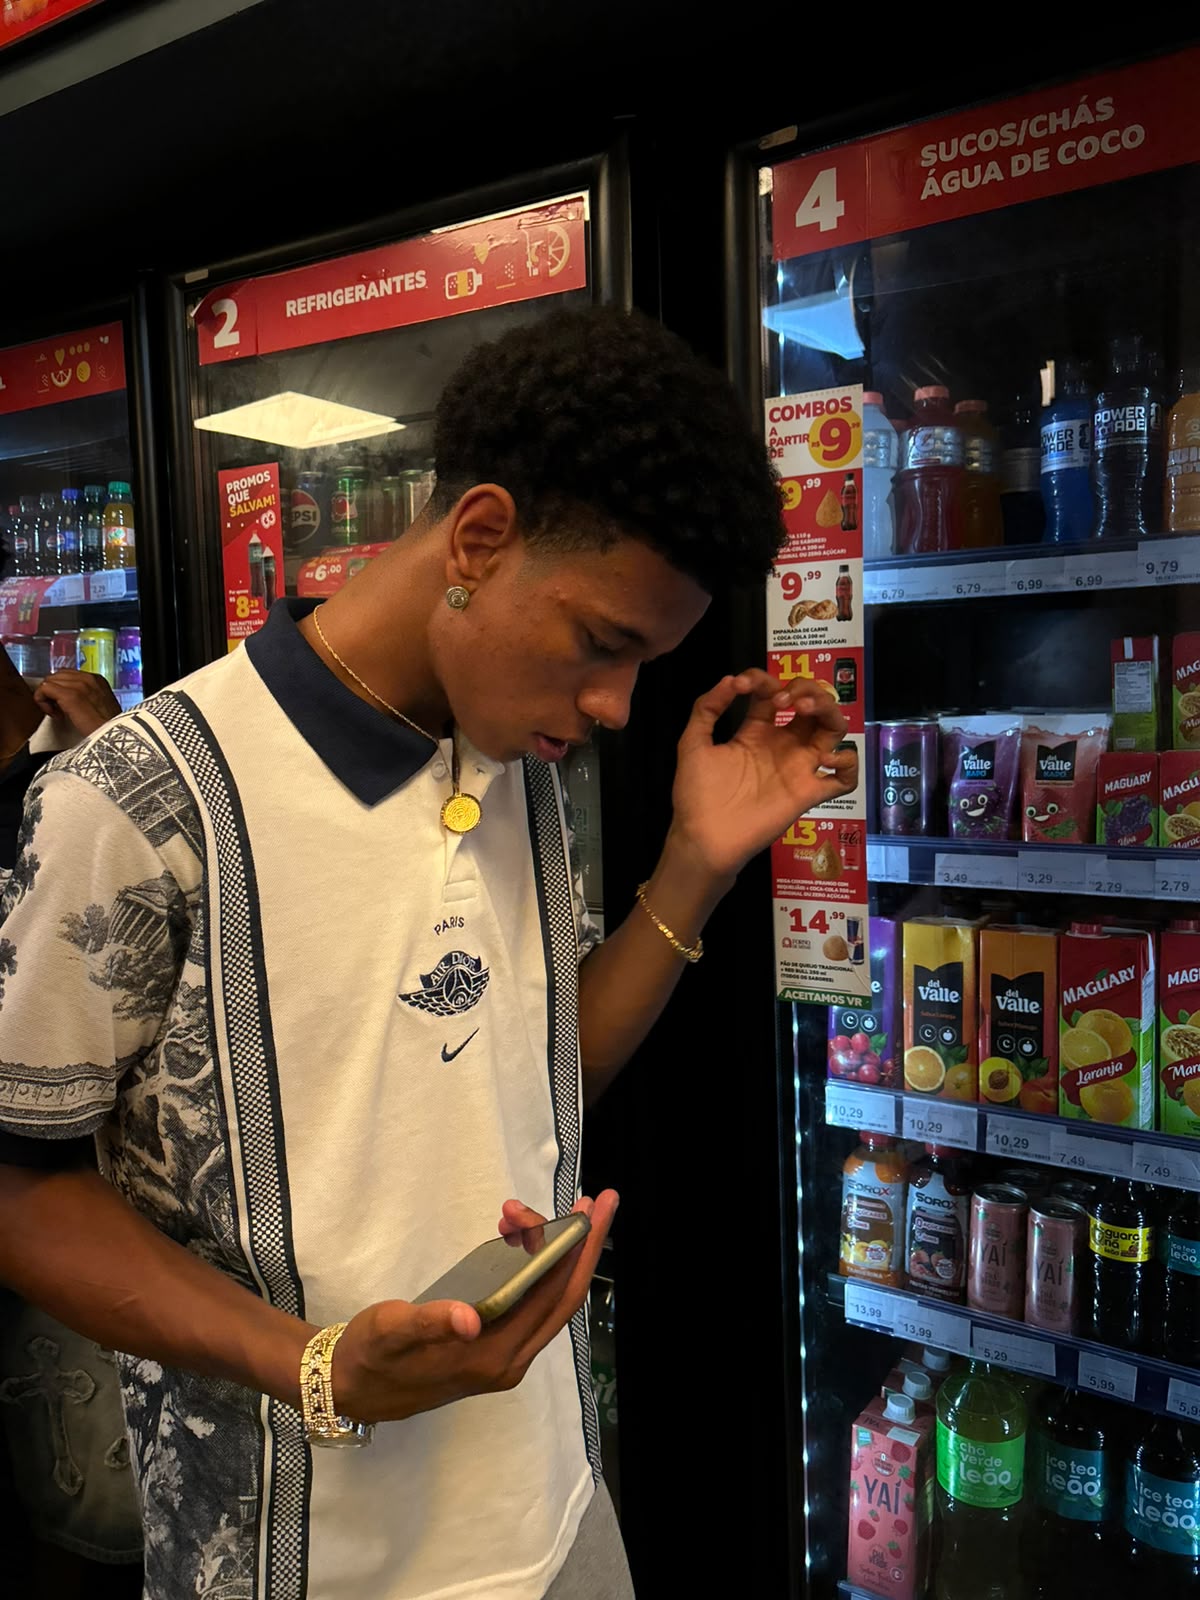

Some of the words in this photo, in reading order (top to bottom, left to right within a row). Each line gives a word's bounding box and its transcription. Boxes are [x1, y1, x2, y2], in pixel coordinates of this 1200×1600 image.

[920, 95, 1116, 168] SUCOS/CHÁS
[920, 161, 1004, 200] ÁGUA
[1010, 153, 1050, 177] DE
[1056, 129, 1146, 170] COCO
[795, 166, 845, 232] 4
[285, 270, 427, 317] REFRIGERANTES
[210, 298, 241, 349] 2
[768, 396, 854, 424] COMBOS
[1094, 405, 1145, 426] POWER
[769, 427, 778, 437] A
[769, 433, 810, 448] PARTIR
[770, 448, 784, 459] DE
[226, 470, 272, 495] PROMOS
[227, 489, 250, 508] QUE
[229, 494, 276, 518] SALVAM!
[1145, 560, 1179, 575] 9,79
[955, 582, 980, 595] 6,79
[1016, 579, 1042, 591] 6,99
[1074, 575, 1102, 587] 6,99
[881, 588, 905, 600] 6,79
[773, 627, 802, 635] EMPANADA
[890, 758, 900, 766] del
[963, 759, 992, 771] Valle
[1040, 759, 1072, 771] Valle
[884, 764, 918, 778] Valle
[1104, 771, 1152, 794] MAGUARY
[943, 872, 967, 884] 3,49
[1027, 872, 1053, 884] 3,29
[1160, 879, 1190, 892] 2,79
[1095, 881, 1122, 893] 2,79
[434, 915, 465, 936] PARIS
[430, 961, 451, 985] AIR
[451, 952, 476, 970] DIOR
[927, 979, 940, 988] del
[1063, 964, 1136, 1006] MAGUARY
[785, 989, 846, 1004] ACEITAMOS
[846, 996, 863, 1007] VR
[917, 986, 960, 1004] Valle
[1005, 989, 1019, 998] del
[995, 995, 1041, 1014] Valle
[1076, 1061, 1123, 1086] Laranja
[833, 1105, 864, 1119] 10,29
[910, 1119, 943, 1134] 10,29
[994, 1134, 1030, 1149] 10,29
[1059, 1153, 1085, 1168] 7,49
[1142, 1163, 1171, 1178] 7,49
[915, 1191, 960, 1210] SOROX
[1170, 1248, 1197, 1264] leão
[1037, 1259, 1064, 1286] YAÍ
[854, 1303, 882, 1319] 13,99
[903, 1323, 932, 1339] 13,99
[984, 1349, 1008, 1362] 5,29
[1089, 1376, 1115, 1392] 5,99
[959, 1451, 1003, 1468] verde
[959, 1461, 1012, 1487] leão
[1069, 1460, 1098, 1477] tea
[1045, 1465, 1100, 1498] leão
[863, 1474, 902, 1516] YAÍ
[1139, 1481, 1163, 1503] ice
[1165, 1492, 1194, 1510] tea
[1139, 1496, 1197, 1531] leão
